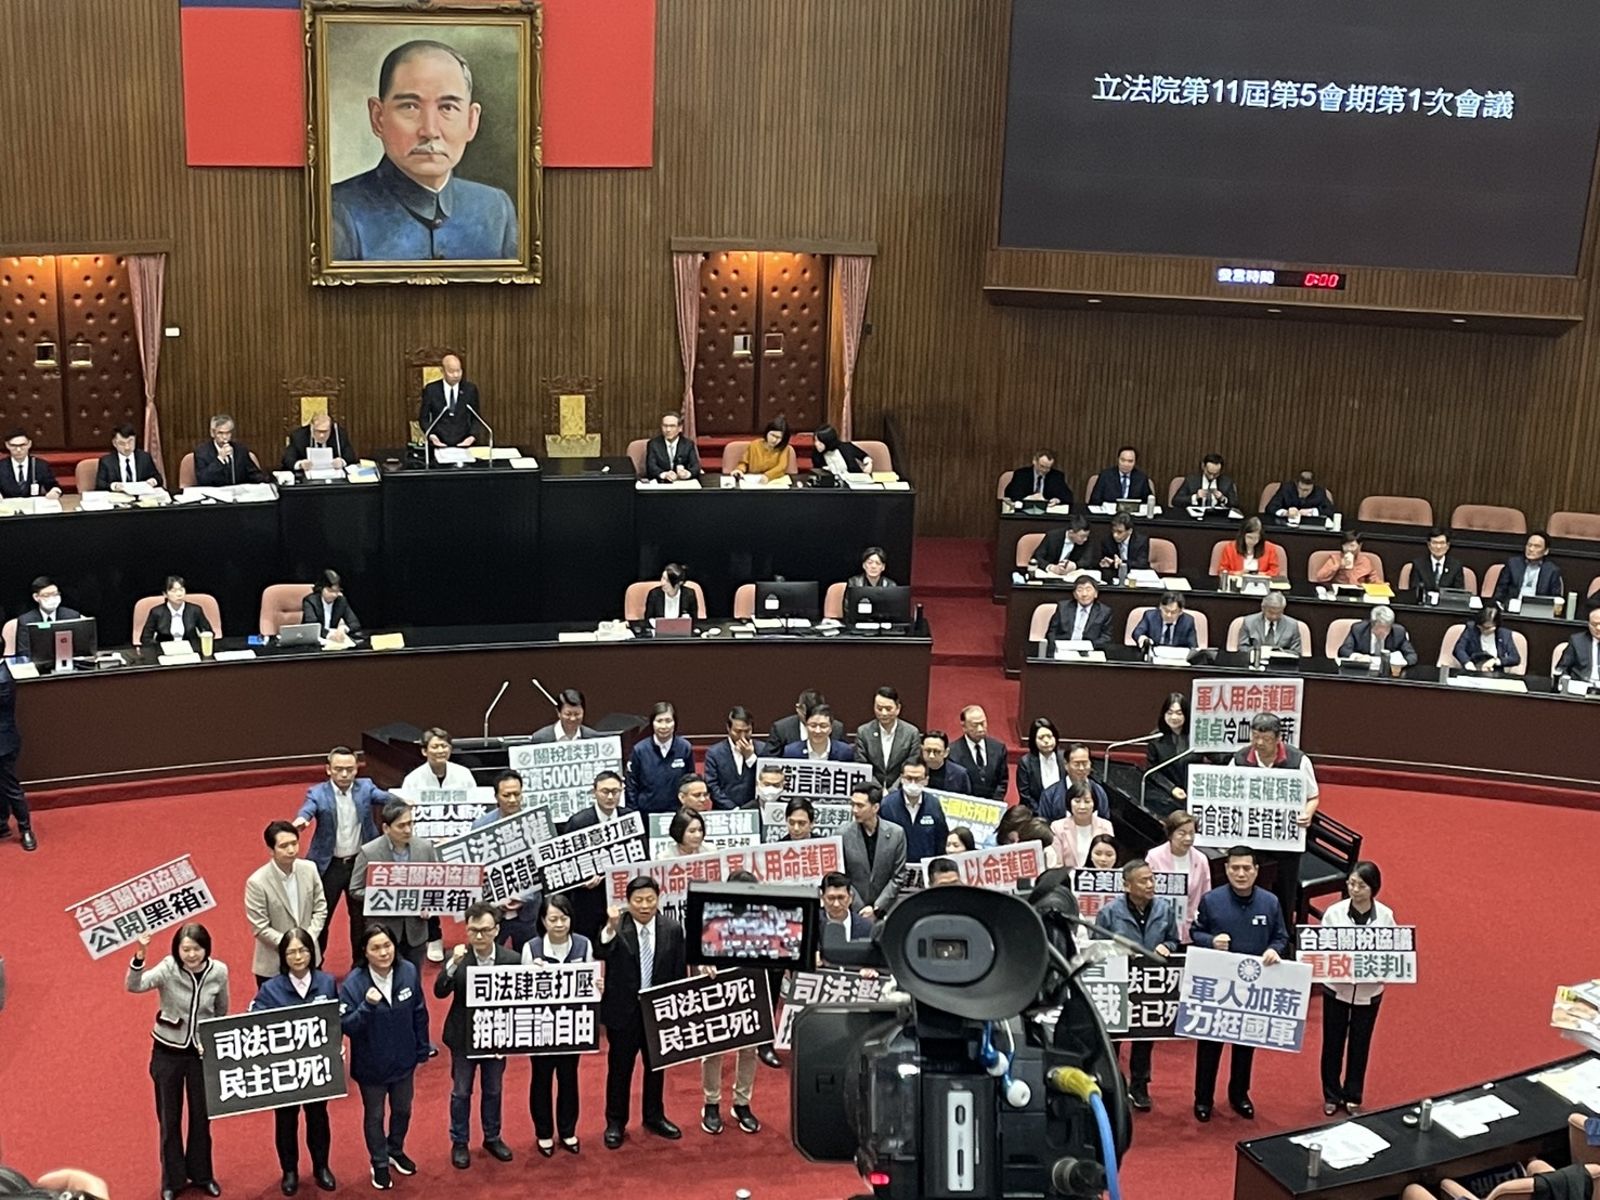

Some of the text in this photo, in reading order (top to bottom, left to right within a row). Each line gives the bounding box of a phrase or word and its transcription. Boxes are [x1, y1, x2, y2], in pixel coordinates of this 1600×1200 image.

[1092, 74, 1514, 119] 立法院第11屆第5會期第1次會議
[1304, 273, 1339, 287] 0:00
[1195, 685, 1297, 712] 軍人用命護國
[1195, 717, 1296, 747] 賴卓冷血薪
[533, 742, 599, 765] 關稅談判
[764, 764, 866, 797] 衛言論自由
[539, 816, 636, 861] 司法肆意打壓
[371, 865, 481, 886] 台美關稅協議
[611, 857, 722, 902] 軍以命護國
[1077, 871, 1186, 895] 台美協議
[89, 886, 208, 953] 公開黑箱!
[1300, 928, 1413, 951] 台美關稅協議
[474, 969, 594, 1002] 司法肆意打壓
[651, 977, 756, 1022] 司法已死!
[793, 972, 884, 1004] 司法濫
[1188, 975, 1302, 1017] 軍人加薪
[213, 1016, 329, 1061] 司法已死!
[473, 1004, 595, 1049] 箝制言論自由
[658, 1009, 761, 1056] 民主已死!
[1184, 1004, 1298, 1047] 力挺國軍
[219, 1054, 332, 1102] 民主已死!
